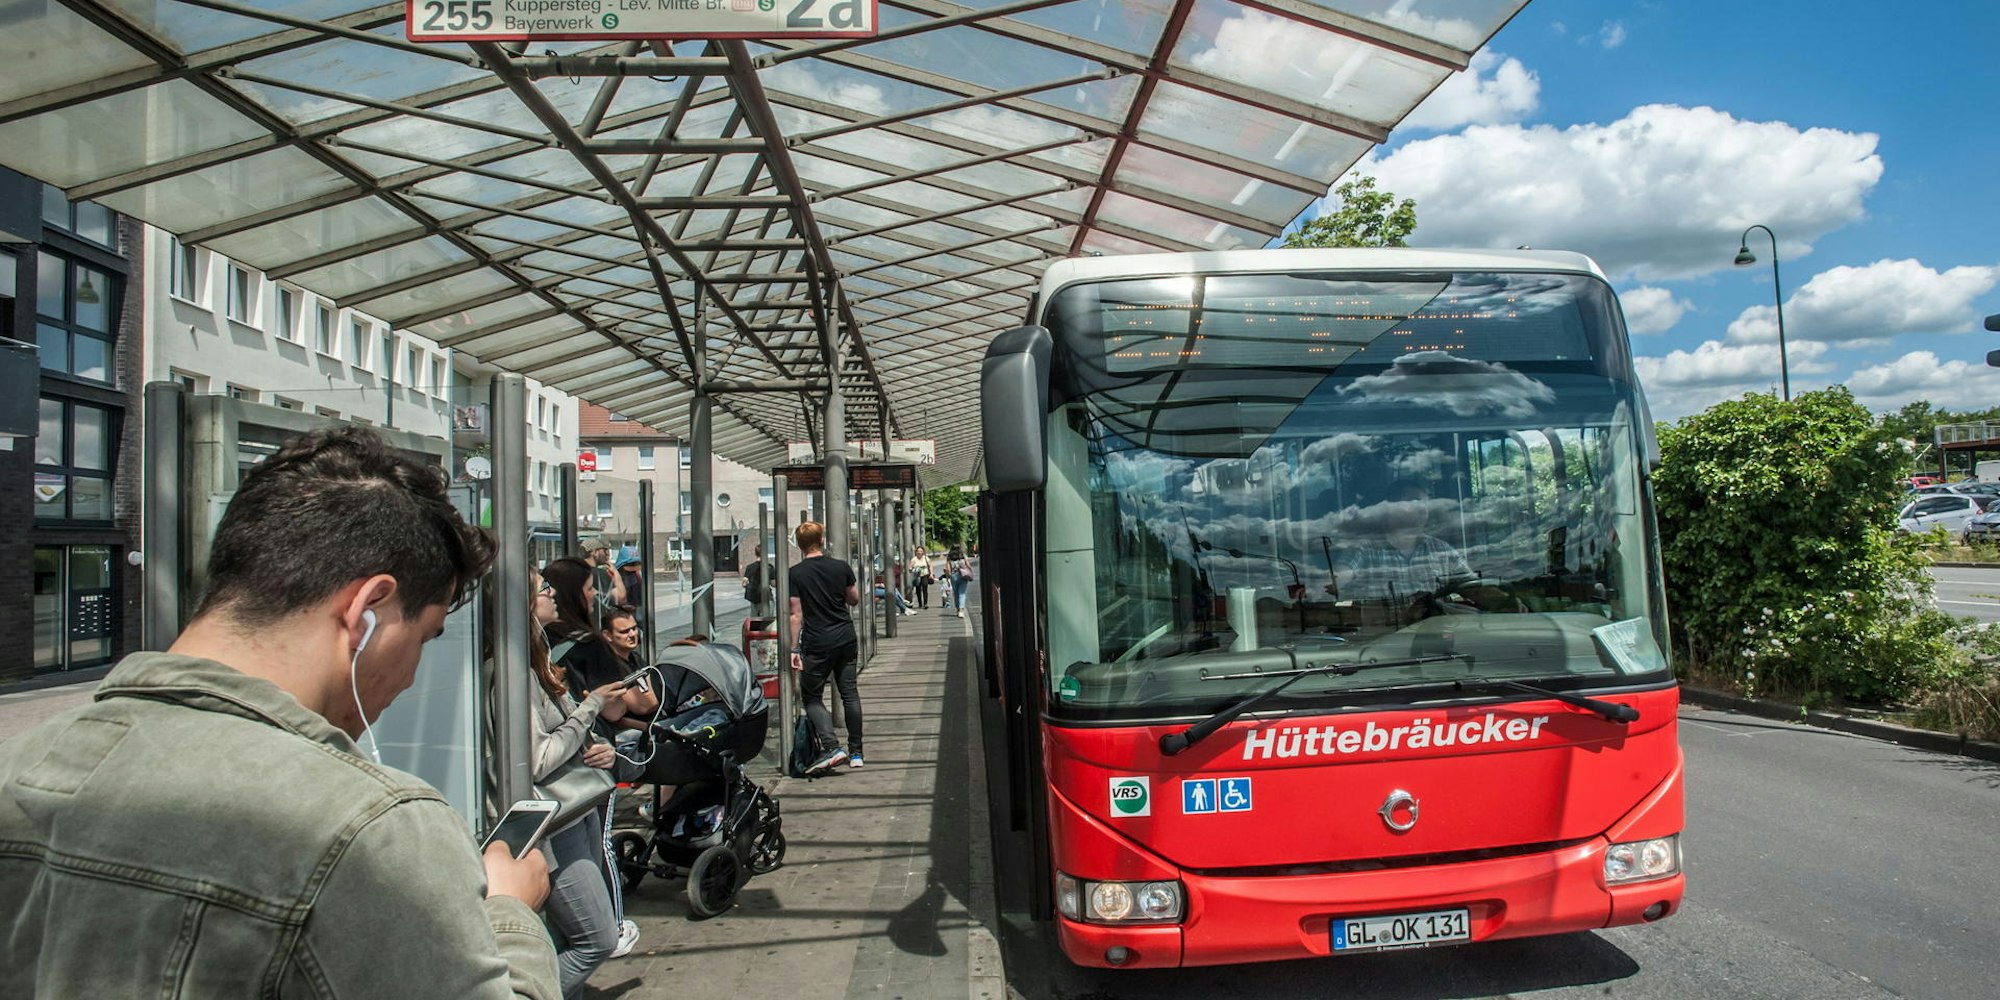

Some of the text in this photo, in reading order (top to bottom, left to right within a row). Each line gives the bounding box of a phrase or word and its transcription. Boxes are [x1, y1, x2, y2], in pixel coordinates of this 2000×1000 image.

[422, 0, 493, 31] 255
[620, 0, 651, 10] Lev.
[658, 0, 699, 10] Mitte
[786, 0, 863, 29] 2a
[505, 16, 593, 32] Bayerwerk
[920, 454, 934, 464] 2b
[1243, 713, 1549, 760] Hüttebräucker
[1112, 787, 1139, 799] VRS
[1347, 914, 1466, 944] GL OK 131
